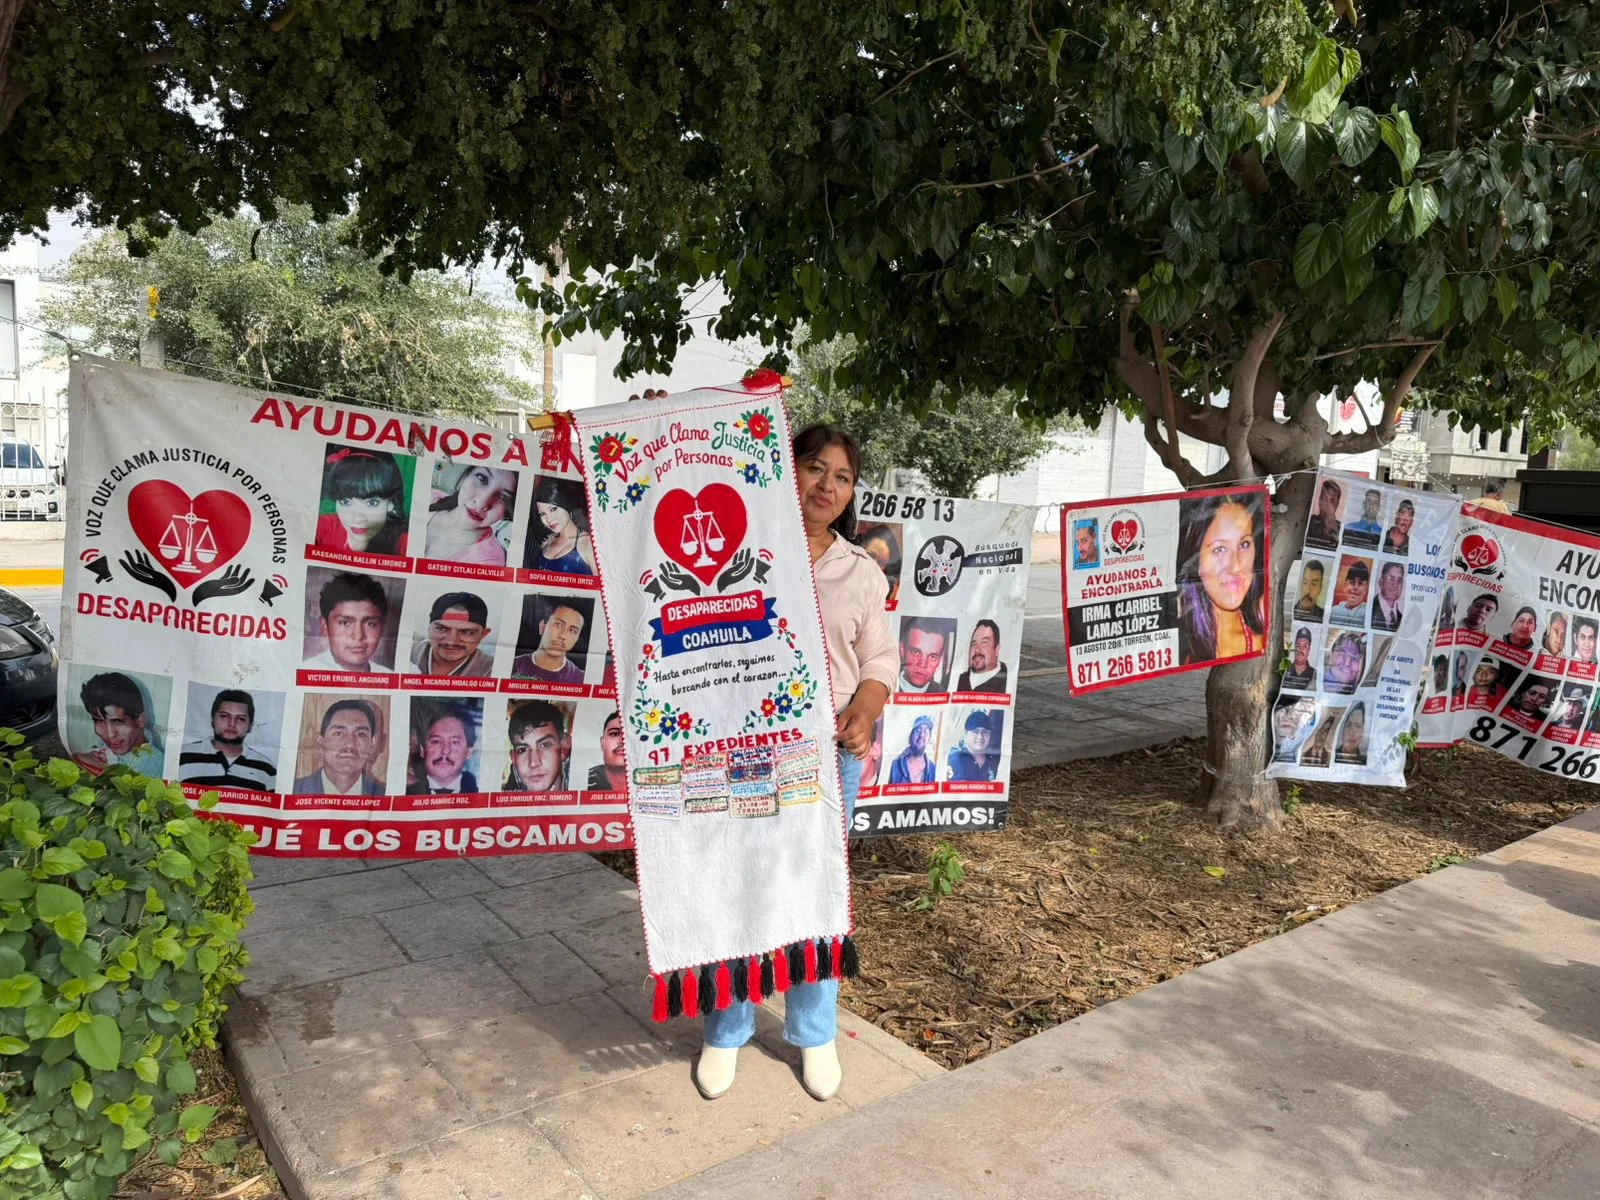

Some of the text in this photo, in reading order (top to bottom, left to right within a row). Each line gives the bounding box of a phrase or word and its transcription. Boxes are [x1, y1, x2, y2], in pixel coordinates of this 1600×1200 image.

[250, 398, 492, 460] AYUDANOS
[501, 438, 529, 466] A
[613, 421, 765, 483] Voz que Clama Justicia
[654, 448, 733, 482] por Personas
[86, 448, 287, 564] VOZ QUE CLAMA JUSTICIA POR PERSONAS
[860, 491, 955, 522] 266 58 13
[311, 549, 407, 568] KASSANDRA BALLIN LIMONES
[427, 563, 504, 577] GATSBY CITLALI CALVILLO
[547, 575, 577, 583] ELIZABETH
[577, 578, 594, 586] ORTIZ
[1086, 566, 1157, 586] AYUDANOS A
[1081, 578, 1162, 599] ENCONTRARLA
[77, 592, 287, 640] DESAPARECIDAS
[667, 595, 758, 622] DESAPARECIDAS
[1082, 596, 1162, 622] IRMA CLARIBEL
[682, 626, 753, 650] COAHUILA
[1087, 614, 1159, 640] LAMAS LÓPEZ
[1075, 646, 1083, 655] 13
[1083, 642, 1107, 653] AGOSTO
[307, 673, 331, 681] VICTOR
[652, 669, 680, 683] Hasta
[737, 654, 775, 670] seguimos
[1077, 647, 1172, 684] 871 266 5813
[403, 677, 423, 685] ANGEL
[424, 678, 451, 686] RICARDO
[479, 680, 495, 688] LUNA
[508, 682, 530, 690] MIGUEL
[551, 685, 583, 693] SAMANIEGO
[671, 678, 711, 696] buscando
[713, 677, 729, 686] con
[732, 672, 741, 683] el
[648, 747, 670, 765] 97
[1469, 716, 1600, 779] 871 266
[217, 791, 249, 800] GARRIDO
[250, 794, 272, 802] SALAS
[496, 795, 510, 803] LUIS
[877, 807, 995, 829] AMAMOS!
[243, 823, 303, 853] UÉ
[318, 828, 401, 852] LOS
